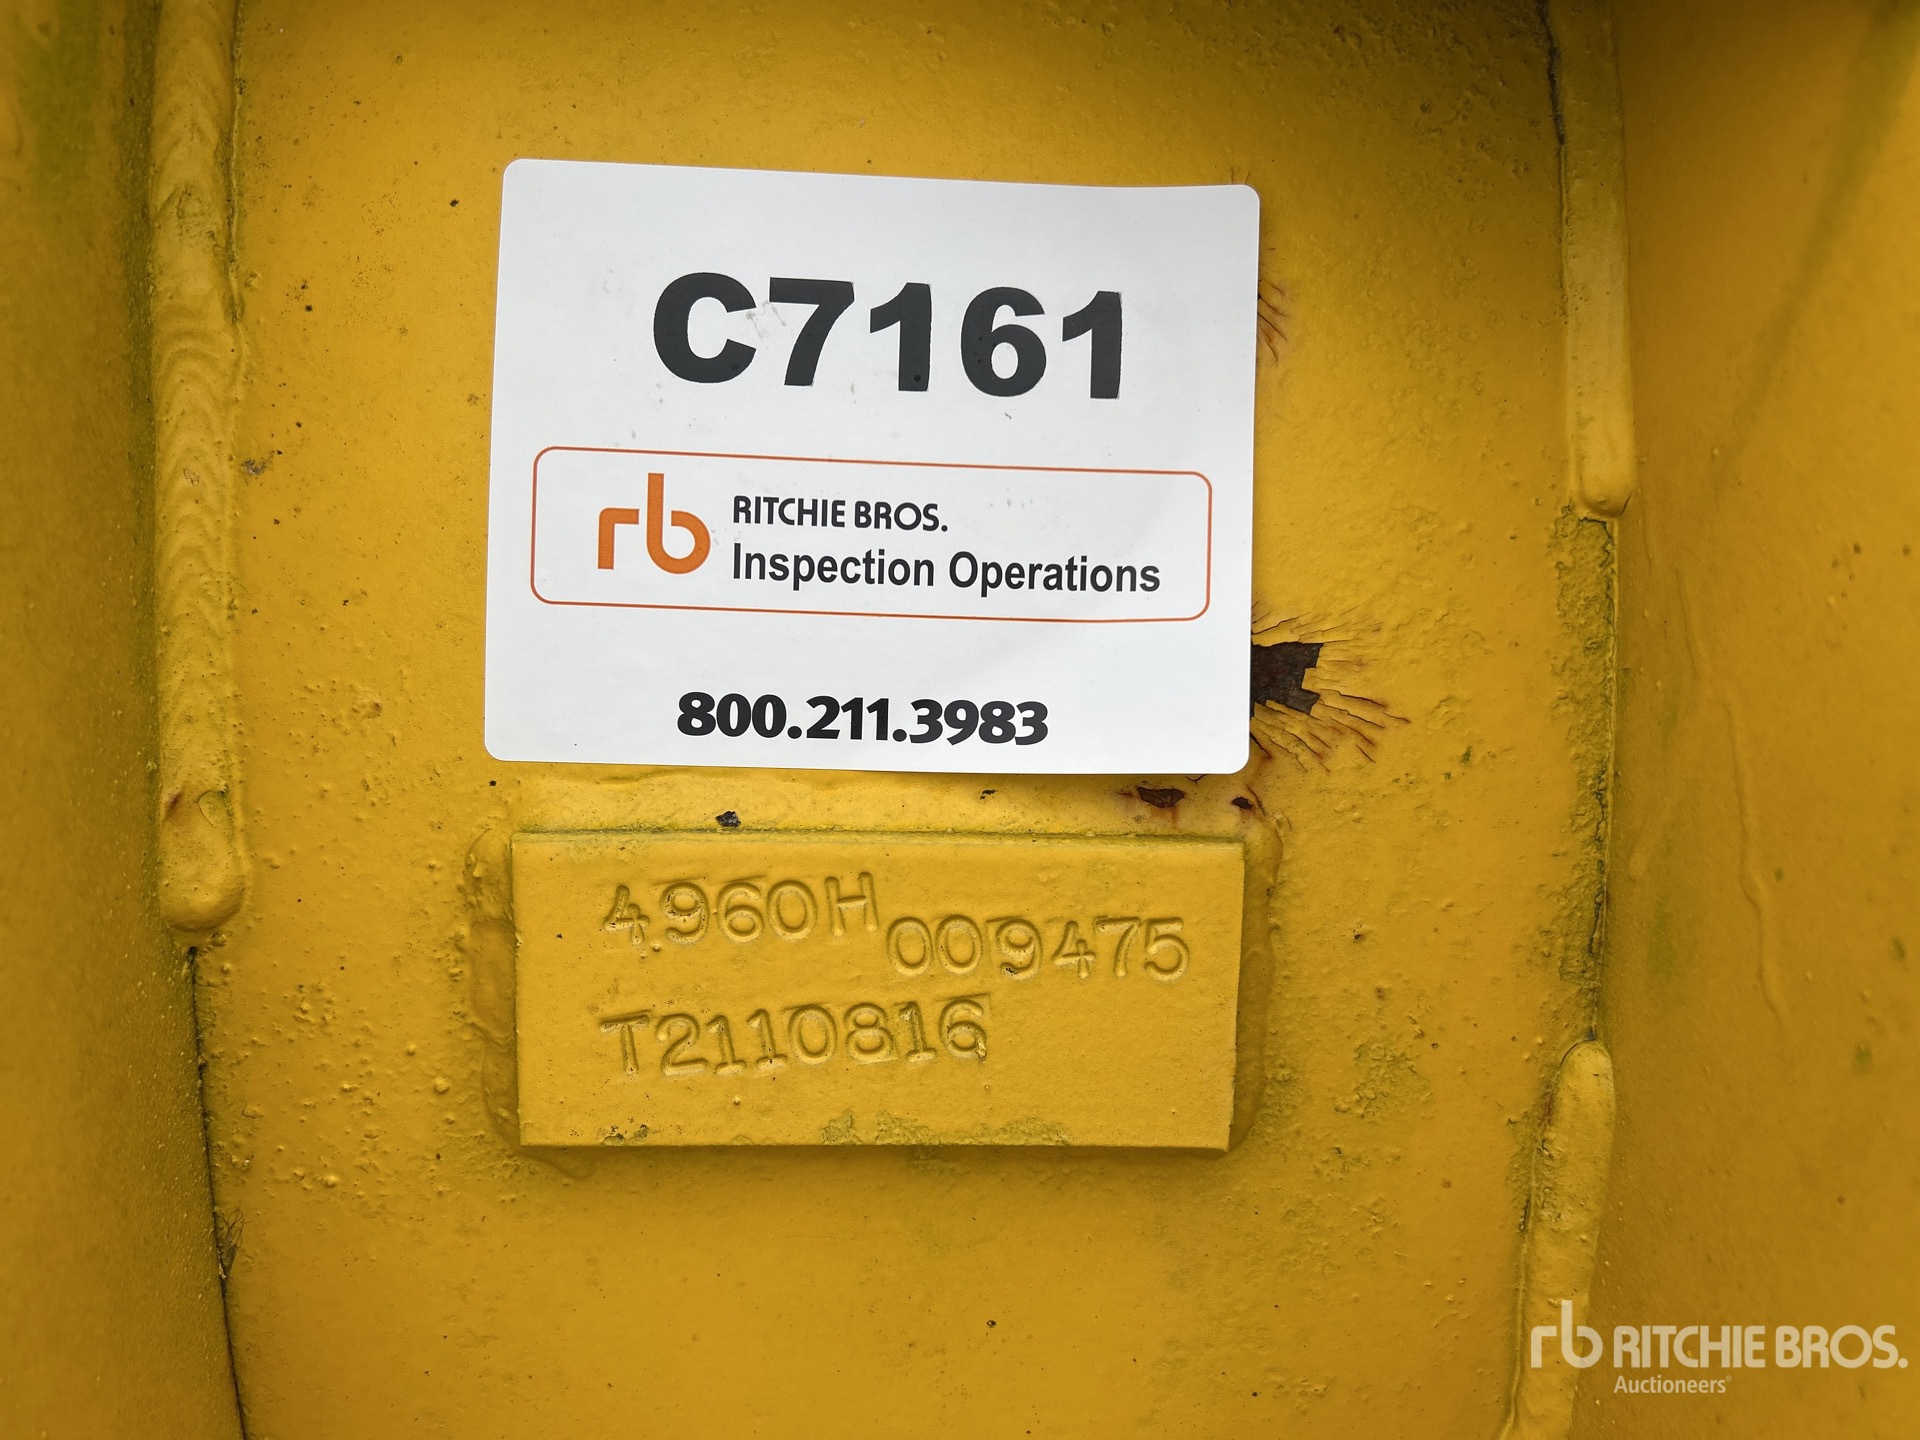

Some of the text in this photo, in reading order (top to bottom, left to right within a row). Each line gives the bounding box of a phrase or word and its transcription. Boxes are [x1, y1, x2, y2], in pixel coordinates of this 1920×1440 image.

[653, 271, 1123, 400] C7161
[598, 473, 711, 574] rb
[733, 495, 948, 532] RITCHIE BROS.
[732, 543, 1161, 598] Inspection Operations
[677, 691, 1049, 746] 800.211.3983
[603, 871, 1190, 981] 4960H 009475
[600, 997, 990, 1077] T2110816
